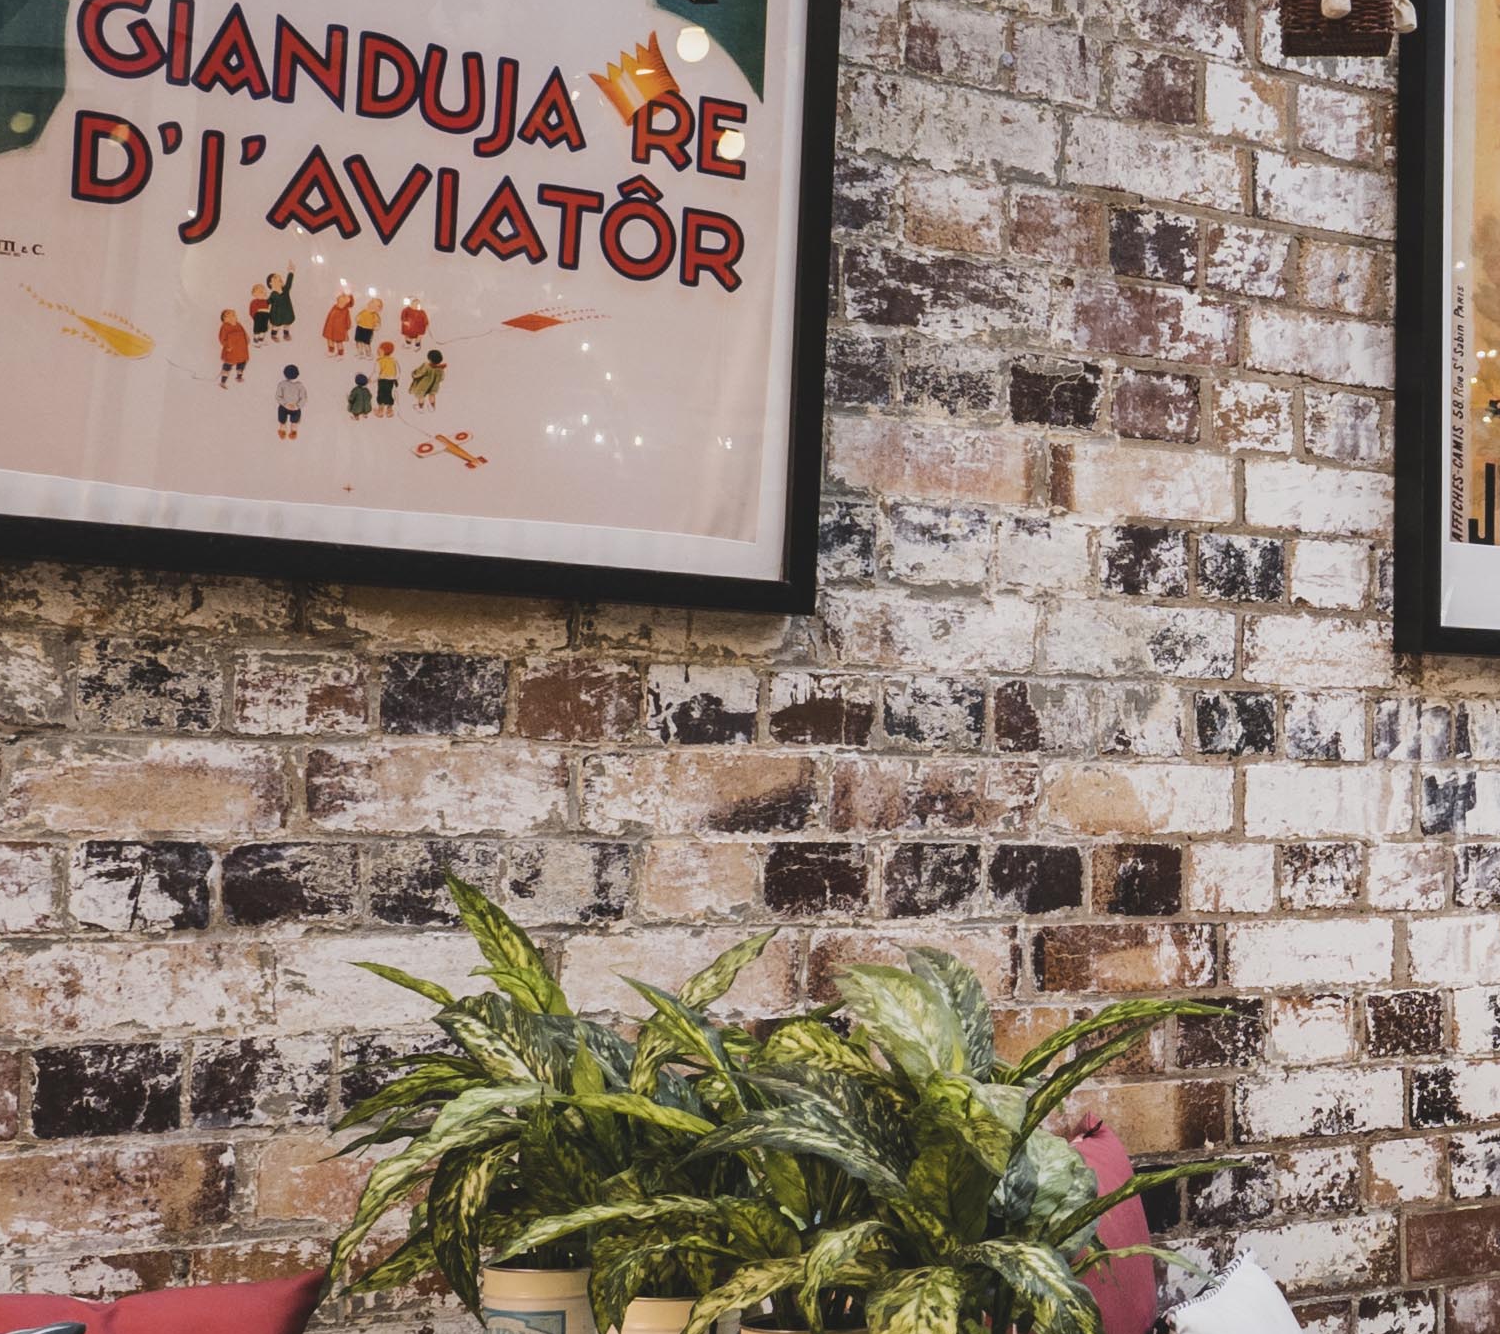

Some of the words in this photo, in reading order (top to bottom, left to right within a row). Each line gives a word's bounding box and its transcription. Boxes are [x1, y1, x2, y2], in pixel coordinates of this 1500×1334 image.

[633, 88, 749, 182] RE
[1453, 324, 1465, 357] Sabin
[1453, 377, 1464, 397] Rue
